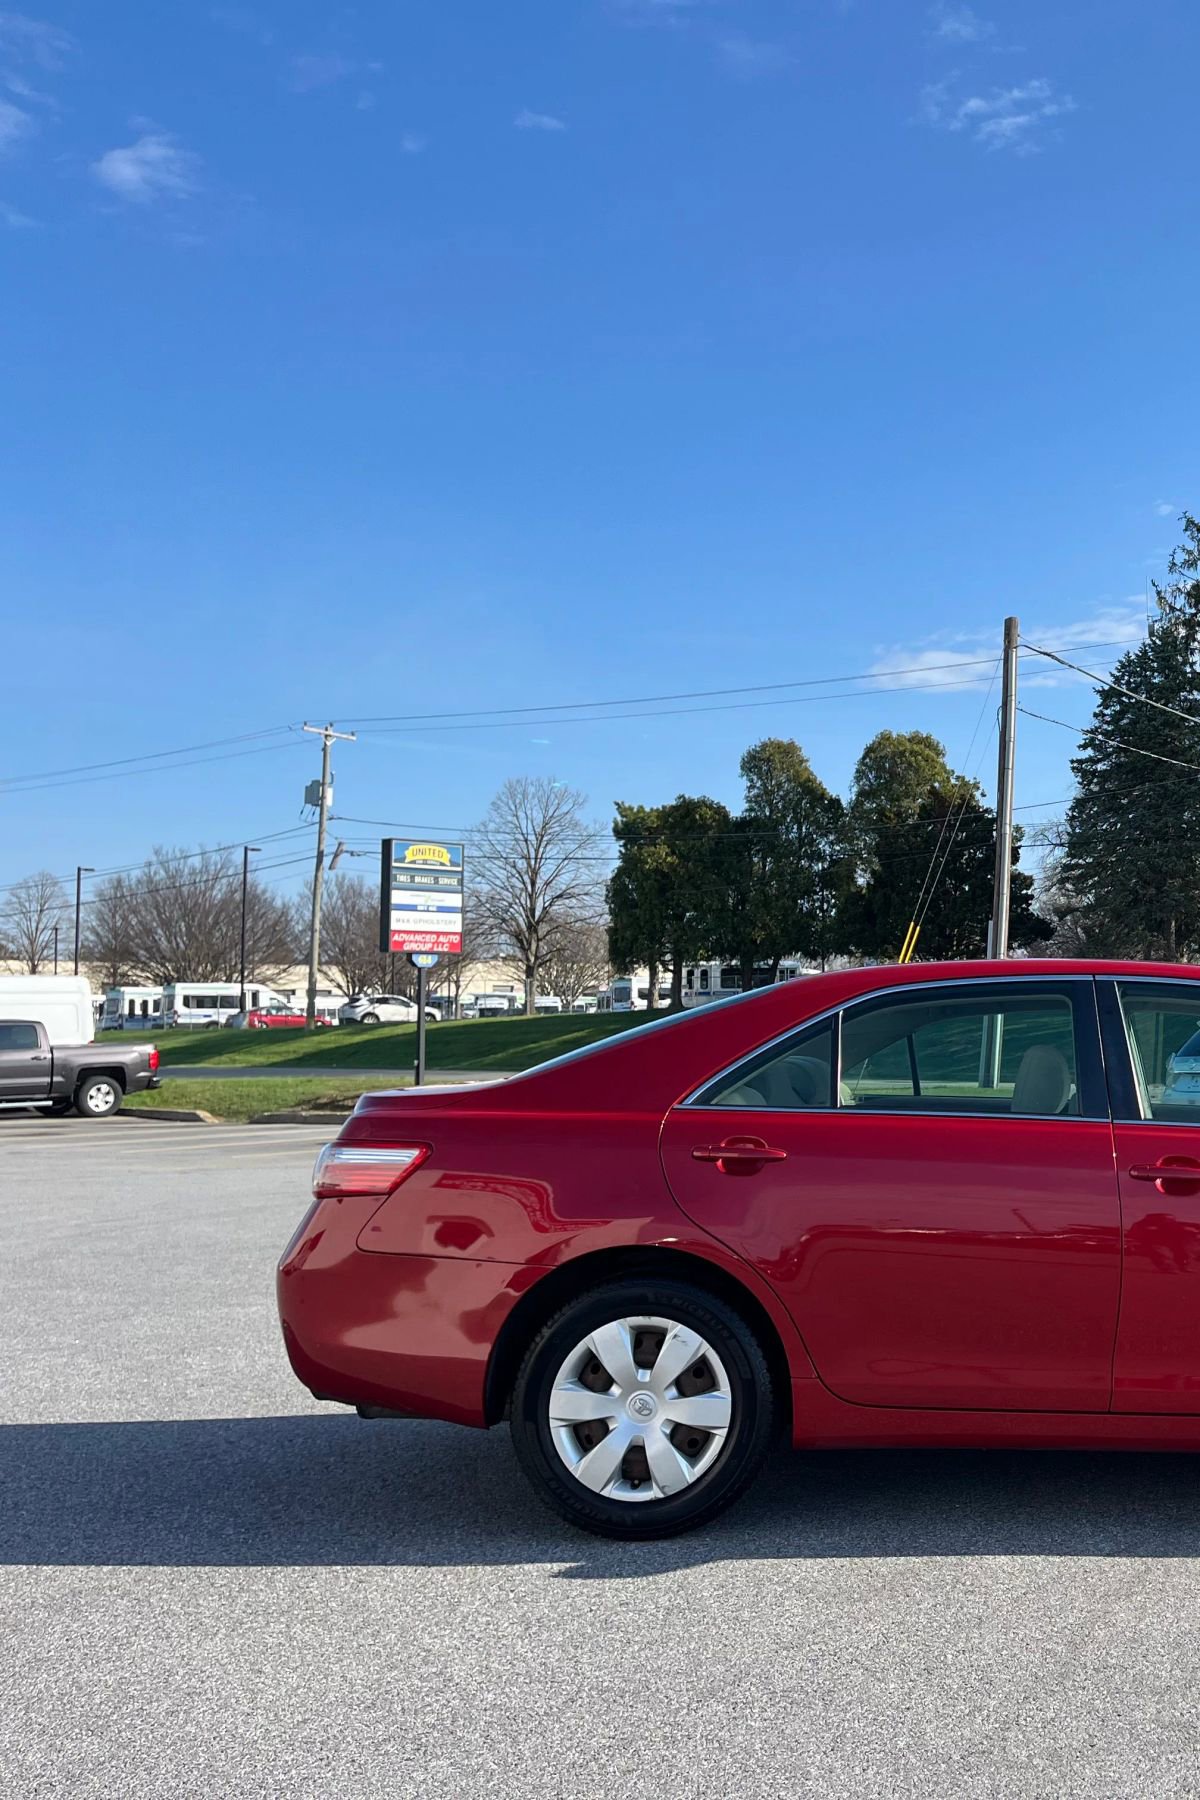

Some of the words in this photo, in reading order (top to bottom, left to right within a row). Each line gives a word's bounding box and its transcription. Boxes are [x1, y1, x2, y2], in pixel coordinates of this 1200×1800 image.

[411, 847, 444, 859] UNITED
[392, 933, 437, 942] ADVANCED
[438, 934, 460, 943] AUTO
[403, 942, 432, 951] GROUP
[433, 943, 449, 952] LLC
